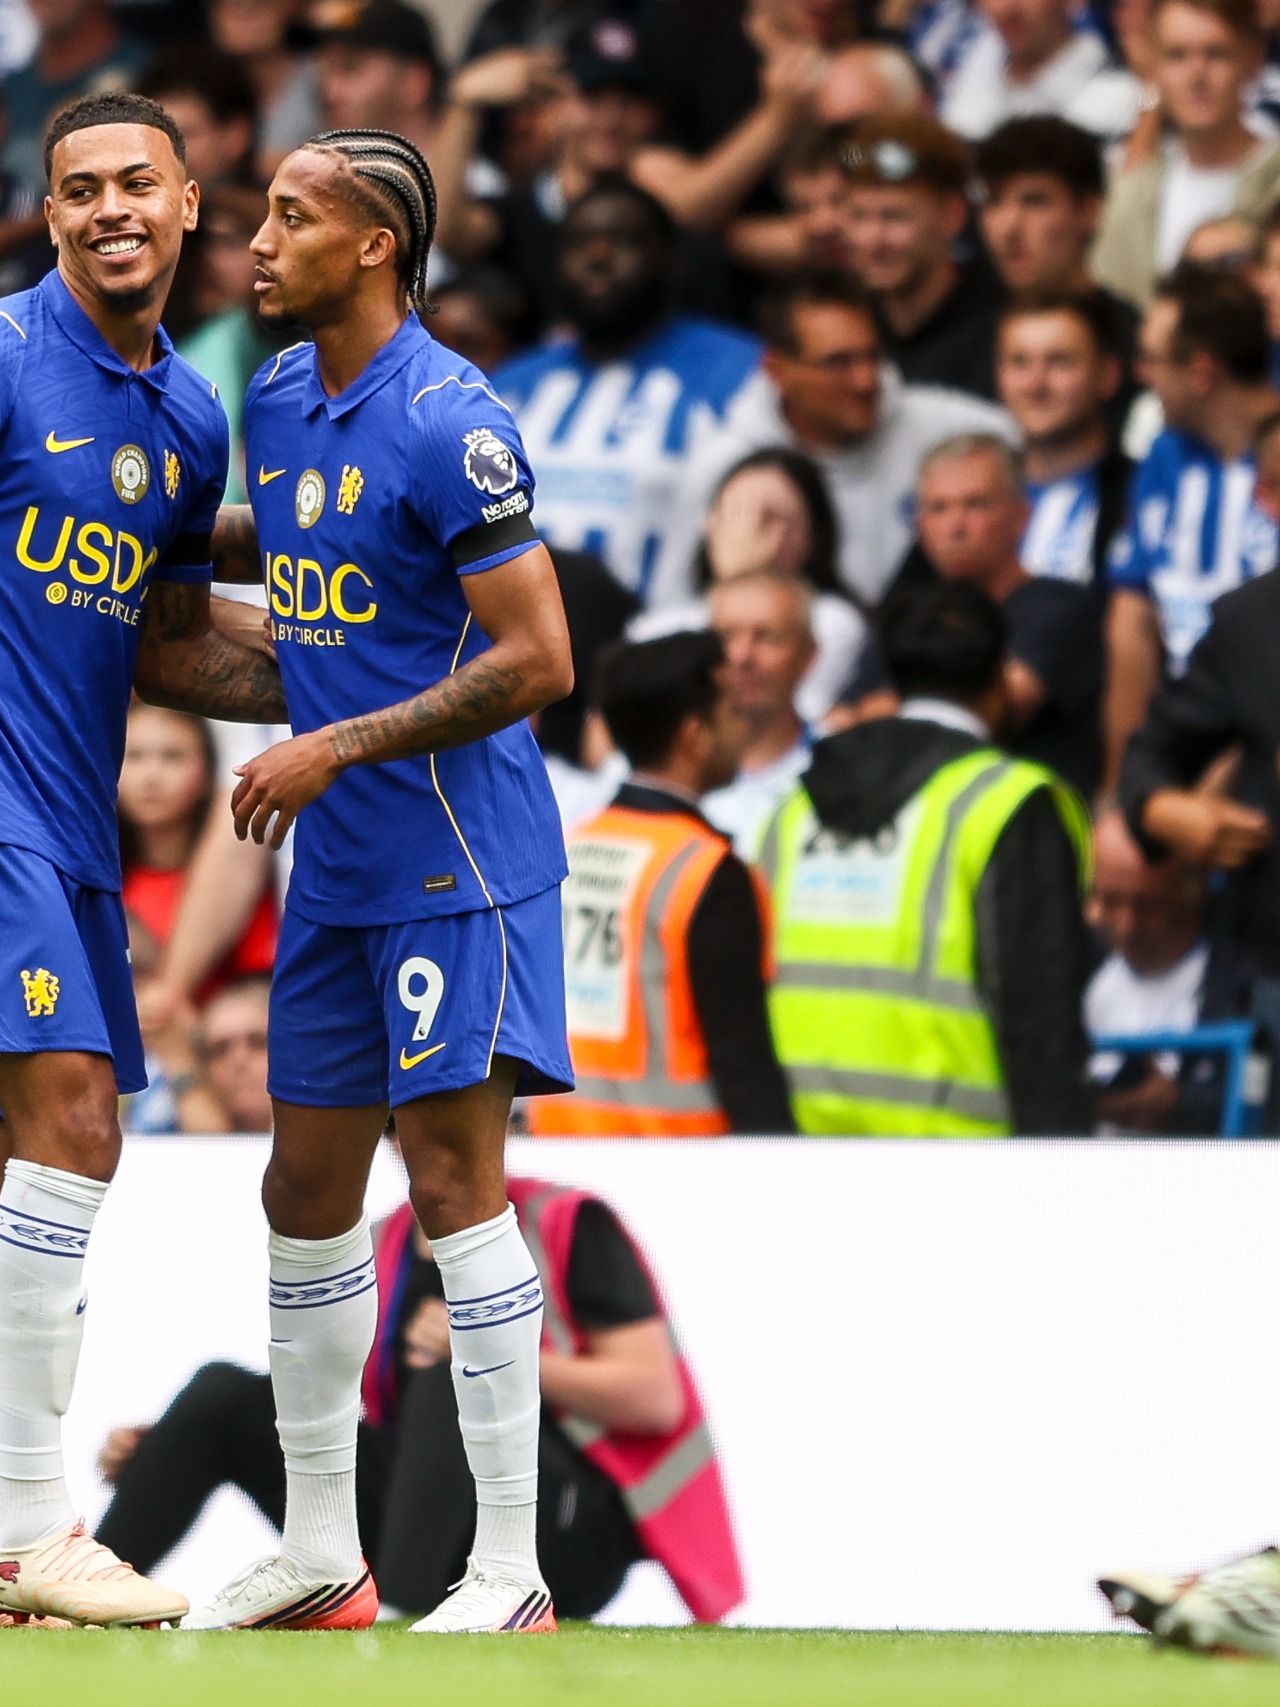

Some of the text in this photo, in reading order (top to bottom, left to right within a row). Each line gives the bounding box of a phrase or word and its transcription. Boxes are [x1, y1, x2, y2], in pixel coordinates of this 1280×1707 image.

[121, 488, 136, 500] FIFA
[481, 491, 525, 518] No room
[71, 589, 94, 609] BY
[266, 551, 377, 624] SDC
[278, 623, 294, 641] BY
[397, 956, 445, 1042] 9
